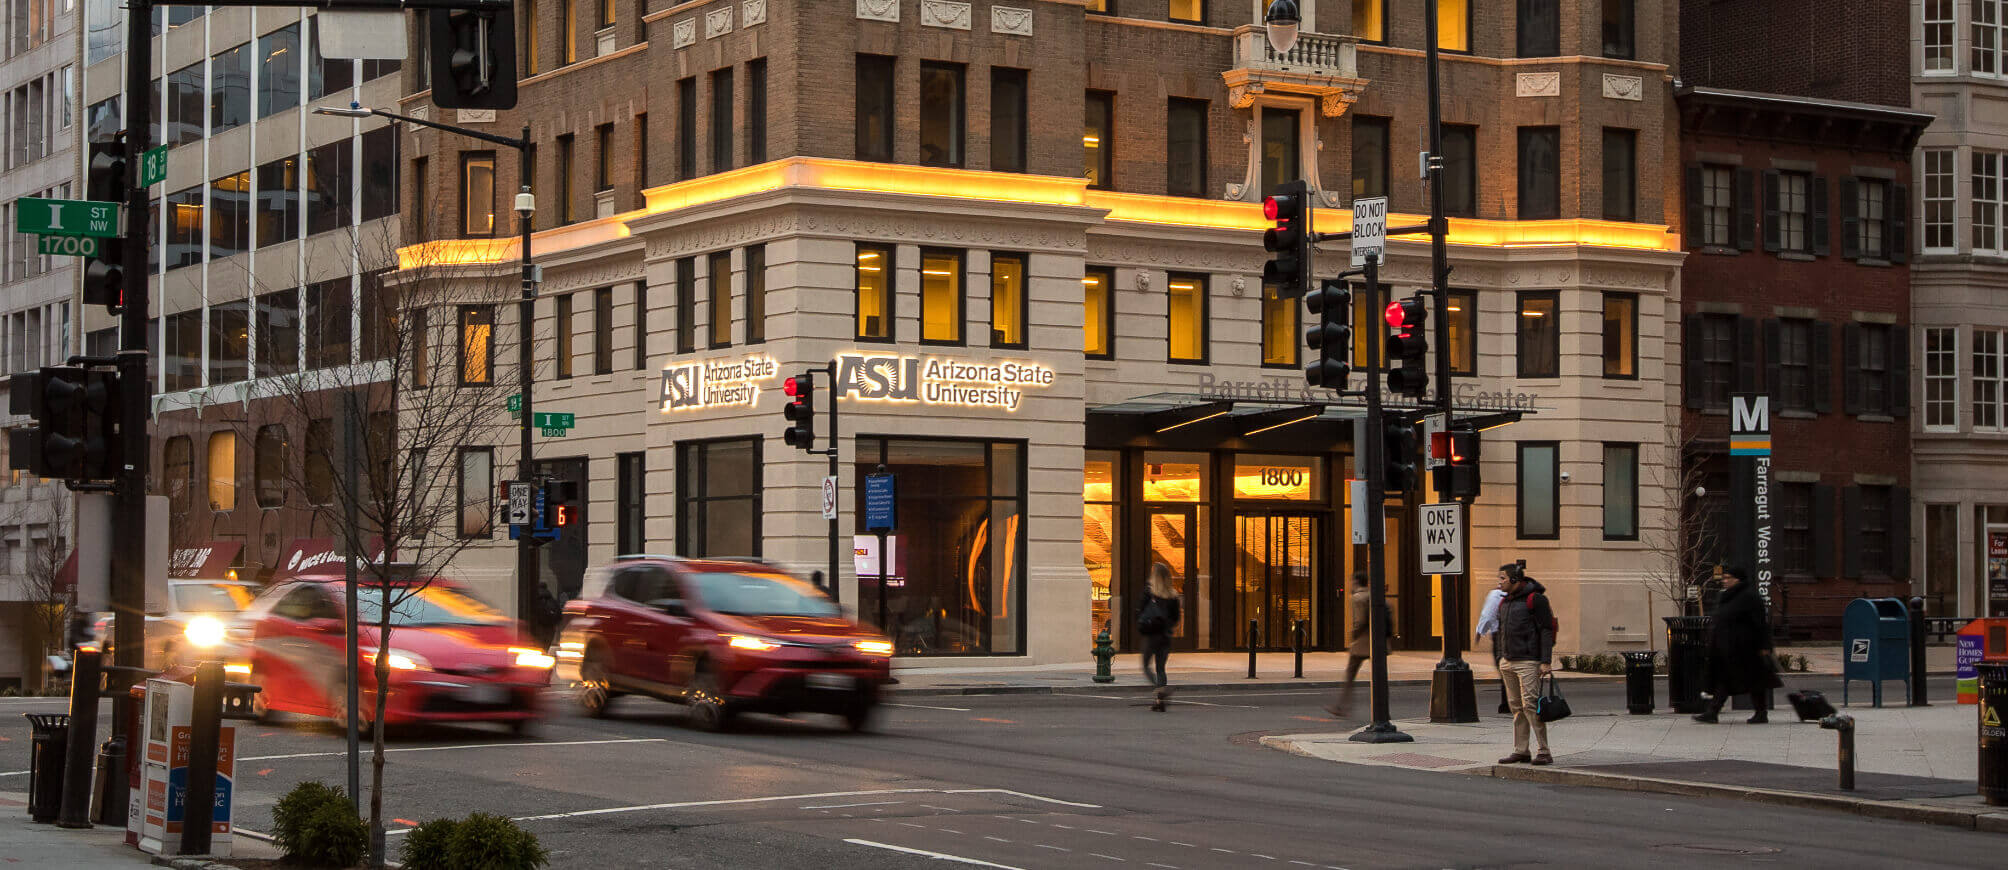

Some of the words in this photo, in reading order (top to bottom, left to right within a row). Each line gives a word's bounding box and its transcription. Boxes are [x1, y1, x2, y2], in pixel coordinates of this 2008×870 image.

[147, 154, 156, 180] 18
[47, 204, 64, 230] I
[91, 207, 108, 219] ST
[1355, 204, 1367, 219] DO
[1369, 202, 1384, 218] NOT
[90, 220, 108, 232] NW
[1354, 222, 1384, 238] BLOCK
[41, 236, 95, 256] 1700
[658, 366, 701, 409] ASU
[704, 364, 742, 381] Arizona
[744, 359, 774, 378] State
[837, 356, 920, 400] ASU
[926, 360, 1000, 381] Arizona
[1003, 364, 1054, 385] State
[704, 384, 758, 405] University
[926, 384, 1021, 409] University
[1199, 372, 1291, 400] Barrett
[1456, 383, 1538, 409] Center
[544, 414, 552, 426] I
[1732, 396, 1769, 432] M
[543, 429, 565, 437] 1800
[1258, 467, 1303, 487] 1800
[512, 487, 527, 497] ONE
[1755, 457, 1770, 520] Farragut
[512, 498, 527, 508] WAY
[558, 506, 566, 525] 6
[1427, 510, 1454, 525] ONE
[1426, 528, 1456, 544] WAY
[1758, 525, 1771, 564] West
[1758, 570, 1772, 614] Stati
